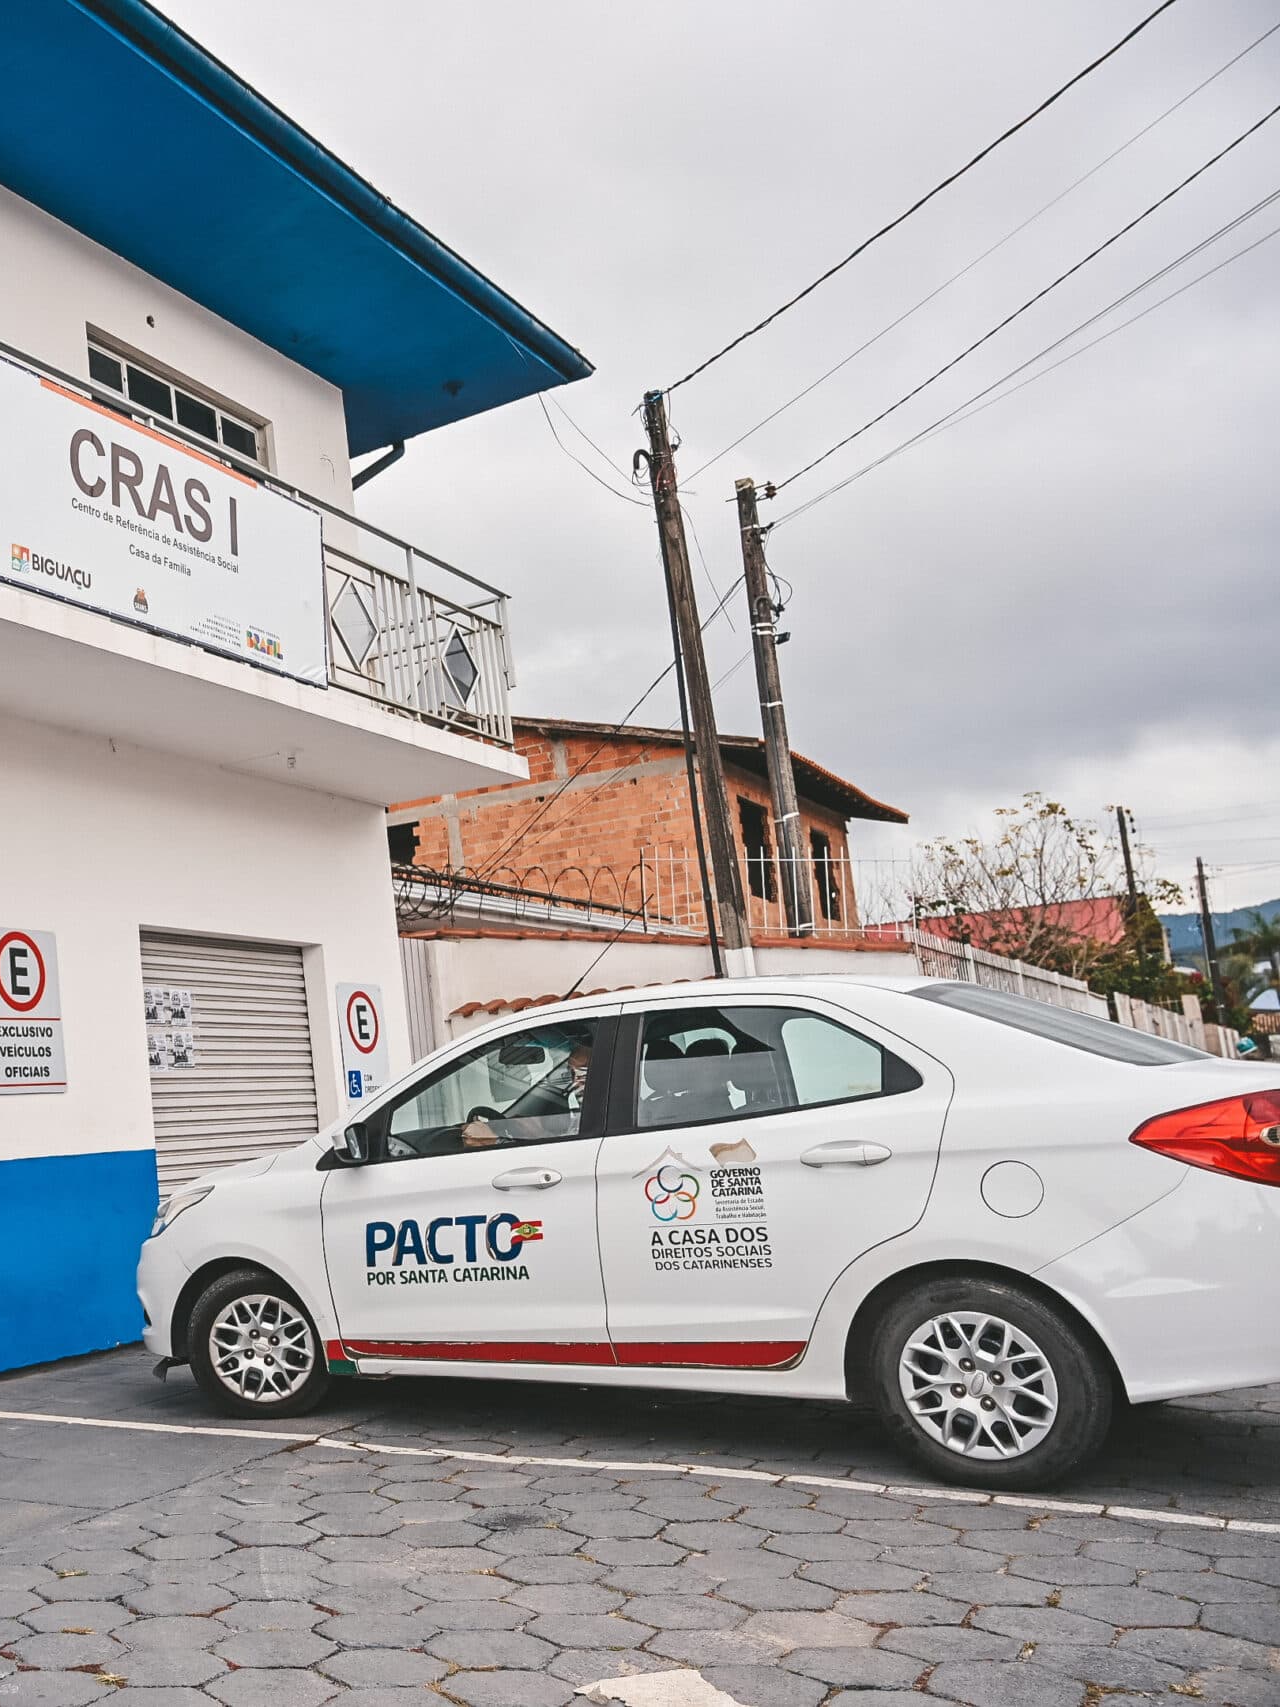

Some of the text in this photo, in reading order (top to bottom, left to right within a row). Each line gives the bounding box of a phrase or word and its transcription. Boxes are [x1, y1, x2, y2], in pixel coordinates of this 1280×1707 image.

[70, 428, 239, 557] CRAS I
[71, 497, 239, 574] Centro de Referência de Assistência Social
[129, 543, 150, 561] Casa
[152, 552, 162, 565] da
[32, 553, 91, 590] BIGUAÇU
[9, 947, 30, 996] E
[356, 1005, 370, 1040] E
[0, 1043, 52, 1058] VEÍCULOS
[5, 1066, 50, 1078] OFICIAIS
[710, 1167, 761, 1179] GOVERNO
[711, 1177, 762, 1189] DE SANTA
[711, 1186, 763, 1198] CATARINA
[366, 1213, 524, 1267] PACTO
[651, 1227, 769, 1246] A CASA DOS
[651, 1244, 772, 1260] DIREITOS SOCIAIS
[655, 1258, 773, 1271] DOS CATARINENSES
[367, 1265, 530, 1286] POR SANTA CATARINA
